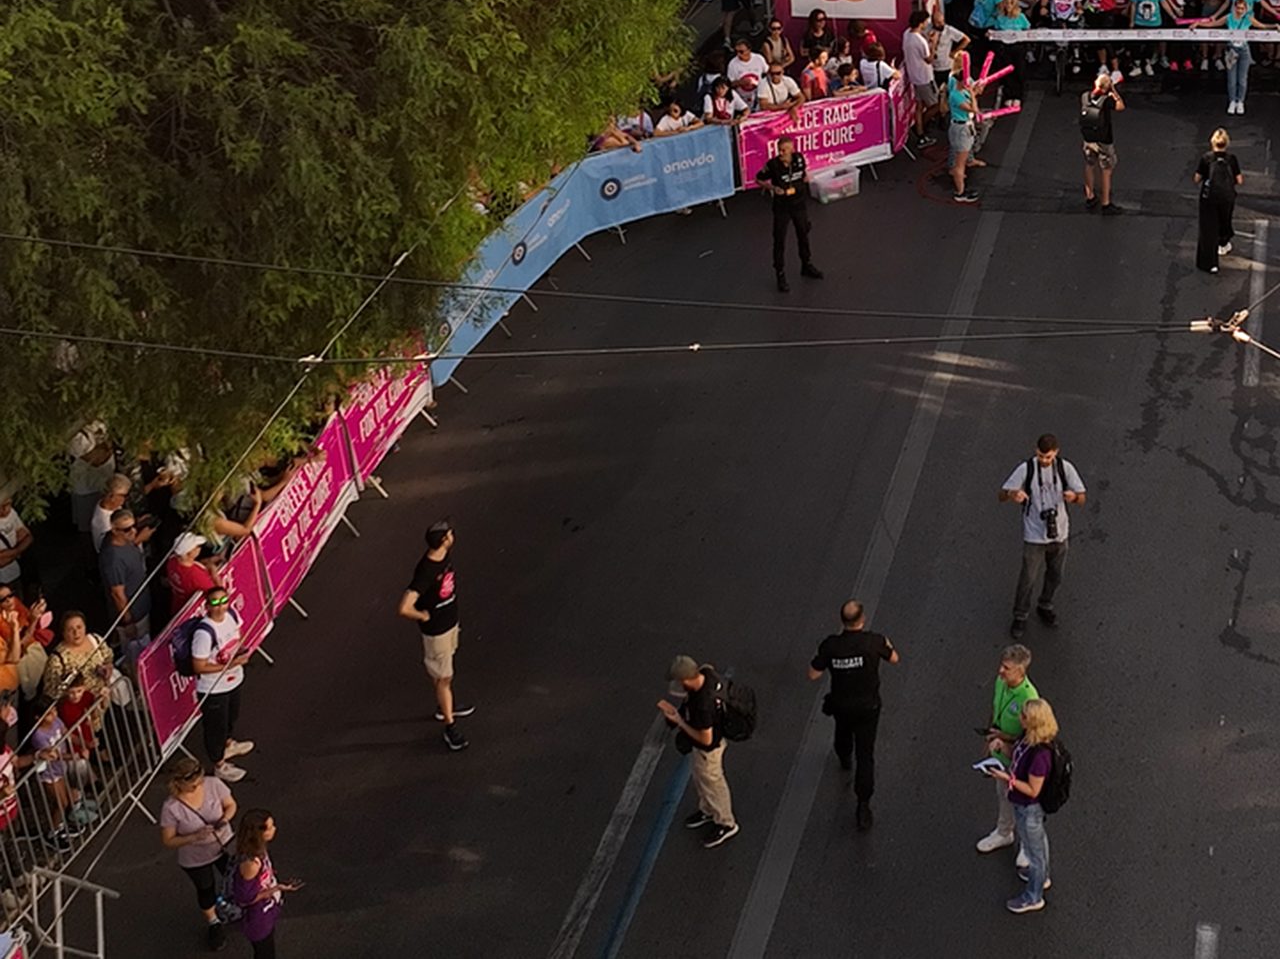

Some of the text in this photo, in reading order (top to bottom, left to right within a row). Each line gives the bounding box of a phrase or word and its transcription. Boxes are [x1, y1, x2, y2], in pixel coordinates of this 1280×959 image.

[824, 102, 858, 126] RACE
[795, 131, 820, 152] THE
[281, 522, 301, 563] FOR
